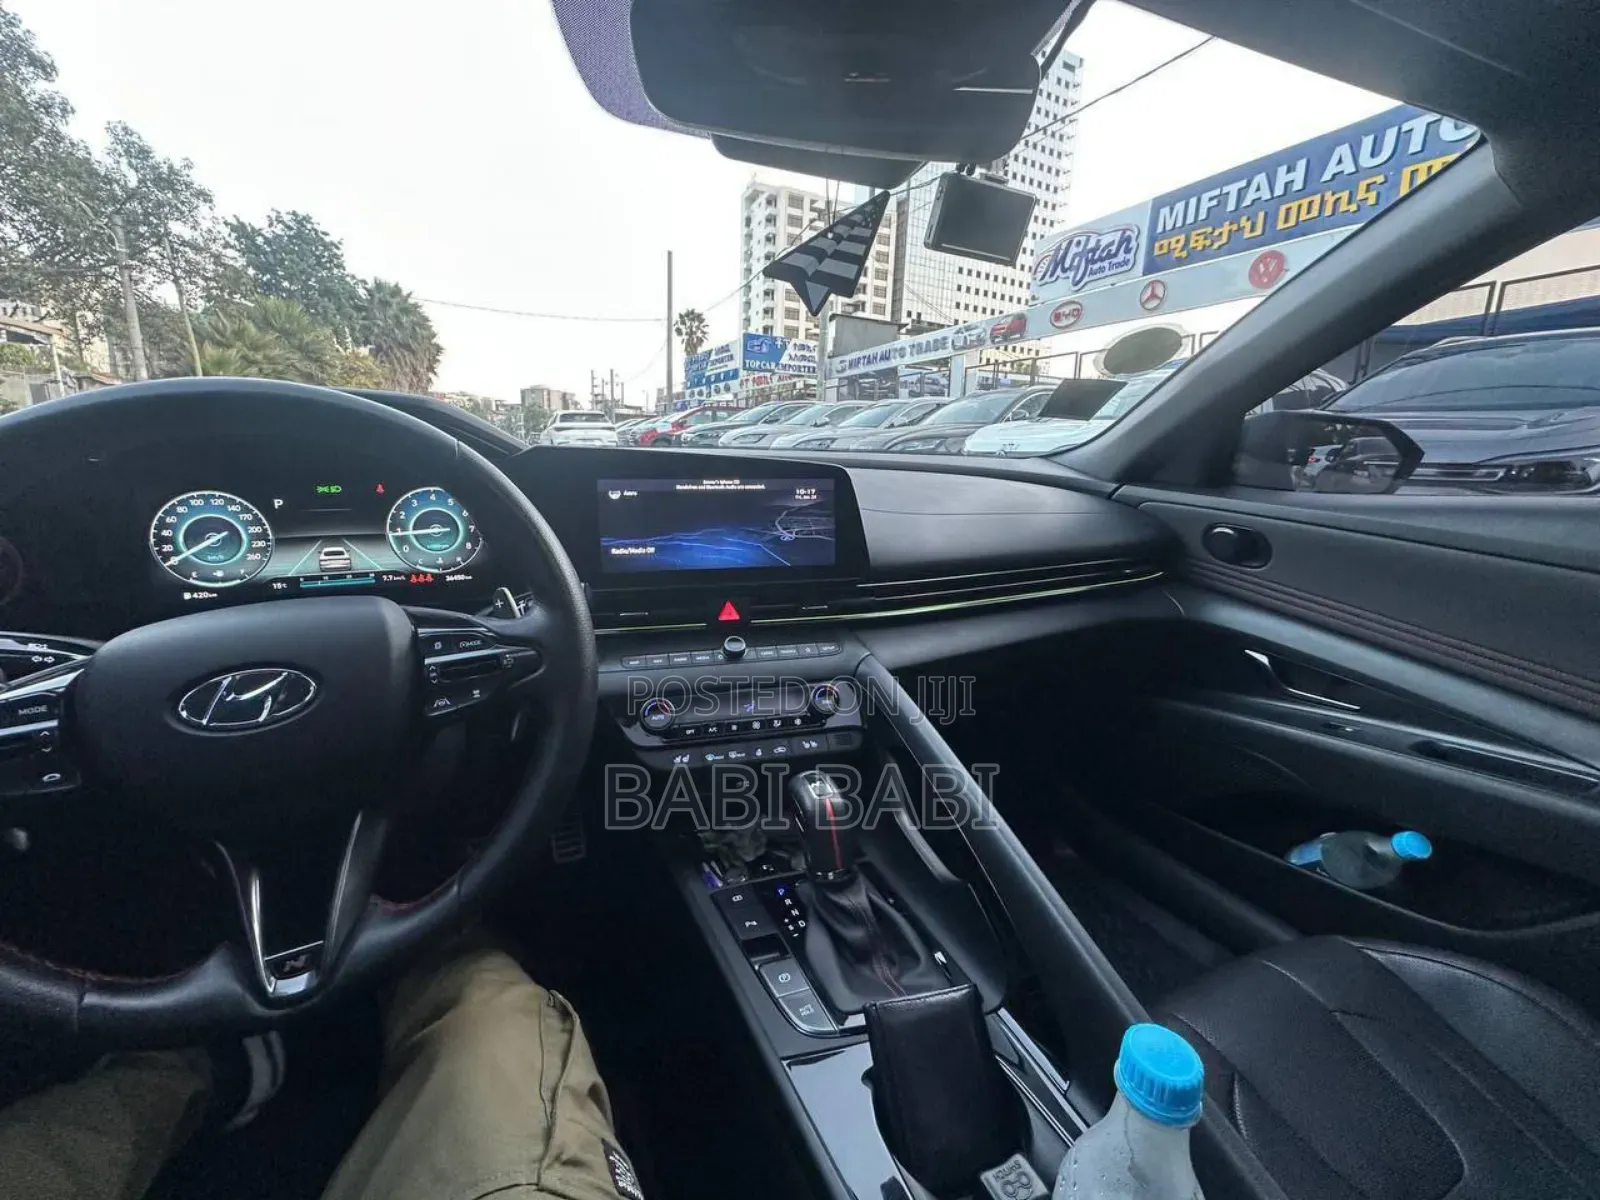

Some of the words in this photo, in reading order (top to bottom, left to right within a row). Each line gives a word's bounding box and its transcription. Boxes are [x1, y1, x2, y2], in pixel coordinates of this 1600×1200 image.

[1157, 157, 1308, 233] MIFTAH
[1039, 228, 1133, 286] Miftah
[1088, 263, 1106, 278] Auto
[1107, 257, 1132, 273] Trade
[879, 344, 906, 364] AUTO
[430, 493, 436, 501] 4
[273, 499, 283, 509] P
[412, 499, 418, 507] 3
[448, 498, 454, 506] 5
[18, 705, 48, 715] MODE
[651, 713, 665, 721] AUTO
[778, 888, 785, 896] P
[791, 909, 800, 917] N
[798, 919, 806, 928] D
